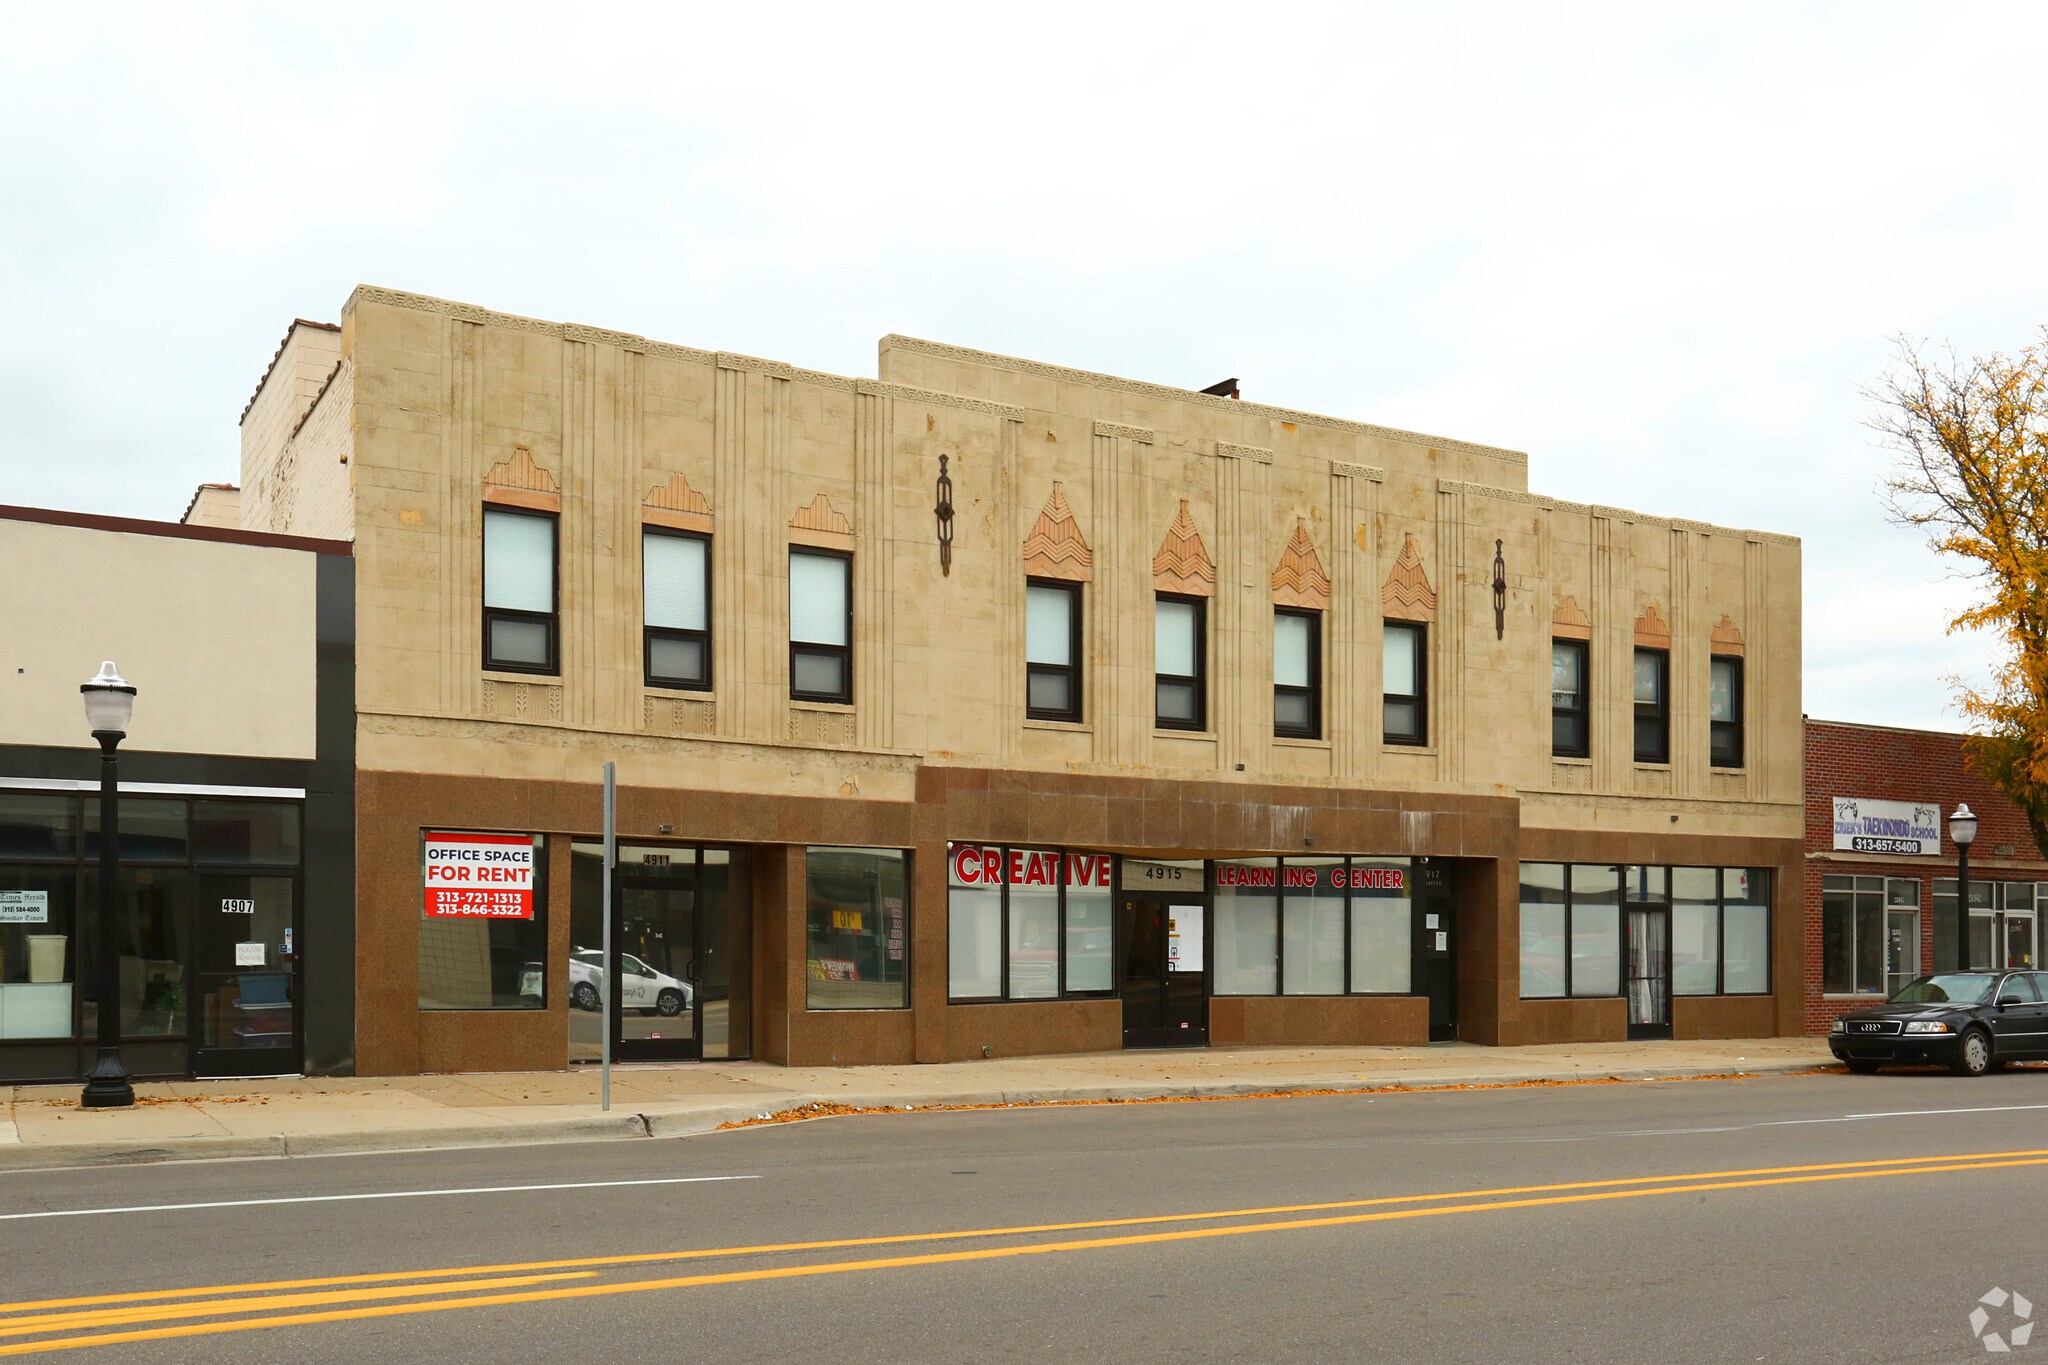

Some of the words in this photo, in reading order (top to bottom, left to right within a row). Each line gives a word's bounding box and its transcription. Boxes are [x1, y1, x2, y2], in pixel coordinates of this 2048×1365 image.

[1862, 816, 1910, 837] TAEKWONDO
[1911, 826, 1938, 840] SCHOOL
[1856, 838, 1918, 852] 313-657-5400
[428, 849, 480, 860] OFFICE
[484, 851, 530, 862] SPACE
[643, 854, 670, 866] 4911
[428, 865, 471, 881] FOR
[477, 867, 530, 882] RENT
[955, 848, 1111, 887] CREATIVE
[1146, 868, 1182, 880] 4915
[436, 891, 522, 903] 313-721-1313
[223, 900, 253, 912] 4907
[436, 903, 522, 915] 313-846-3322
